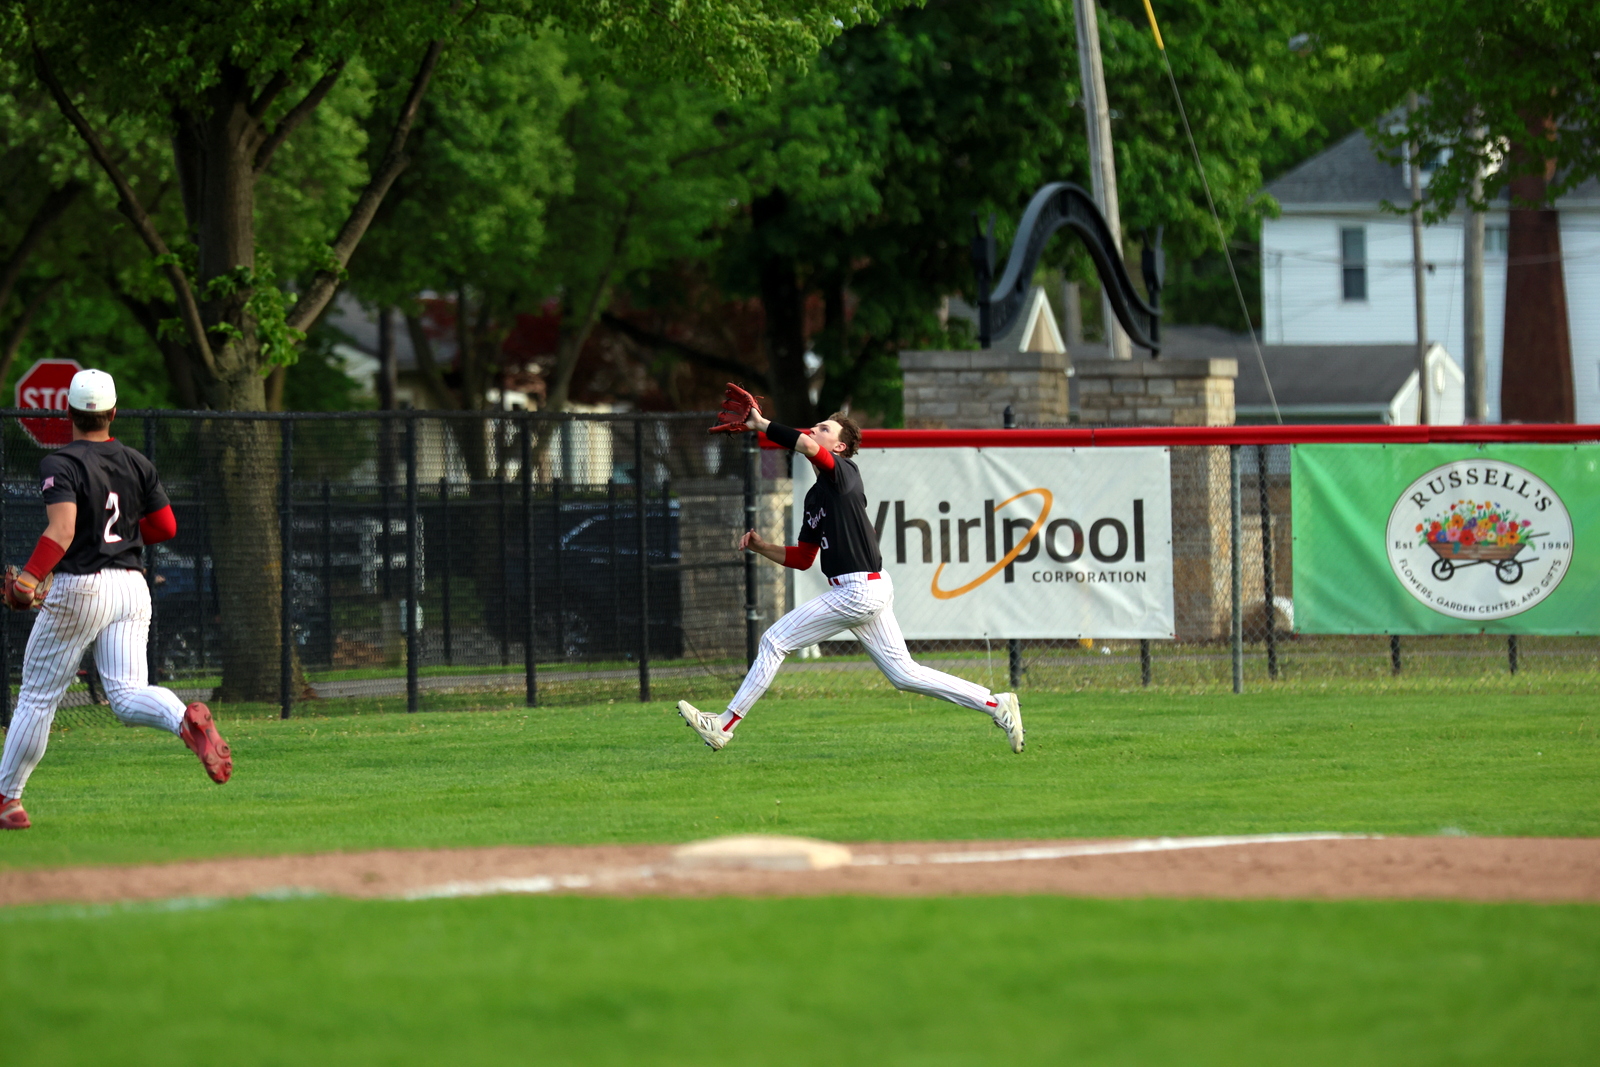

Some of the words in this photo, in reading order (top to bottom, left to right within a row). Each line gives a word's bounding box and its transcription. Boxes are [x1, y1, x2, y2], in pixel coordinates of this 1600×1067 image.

[23, 387, 70, 420] STO
[1410, 468, 1552, 512] RUSSELL'S
[103, 491, 123, 543] 2
[874, 498, 1146, 584] hirlpool
[1395, 541, 1413, 550] Est
[1542, 541, 1570, 550] 1980
[1031, 570, 1147, 583] CORPORATION
[1399, 558, 1434, 602] FLOWERS,
[1436, 596, 1476, 613] GARDEN
[1478, 599, 1521, 614] CENTER,
[1521, 586, 1541, 603] AND
[1541, 558, 1562, 588] GIFTS
